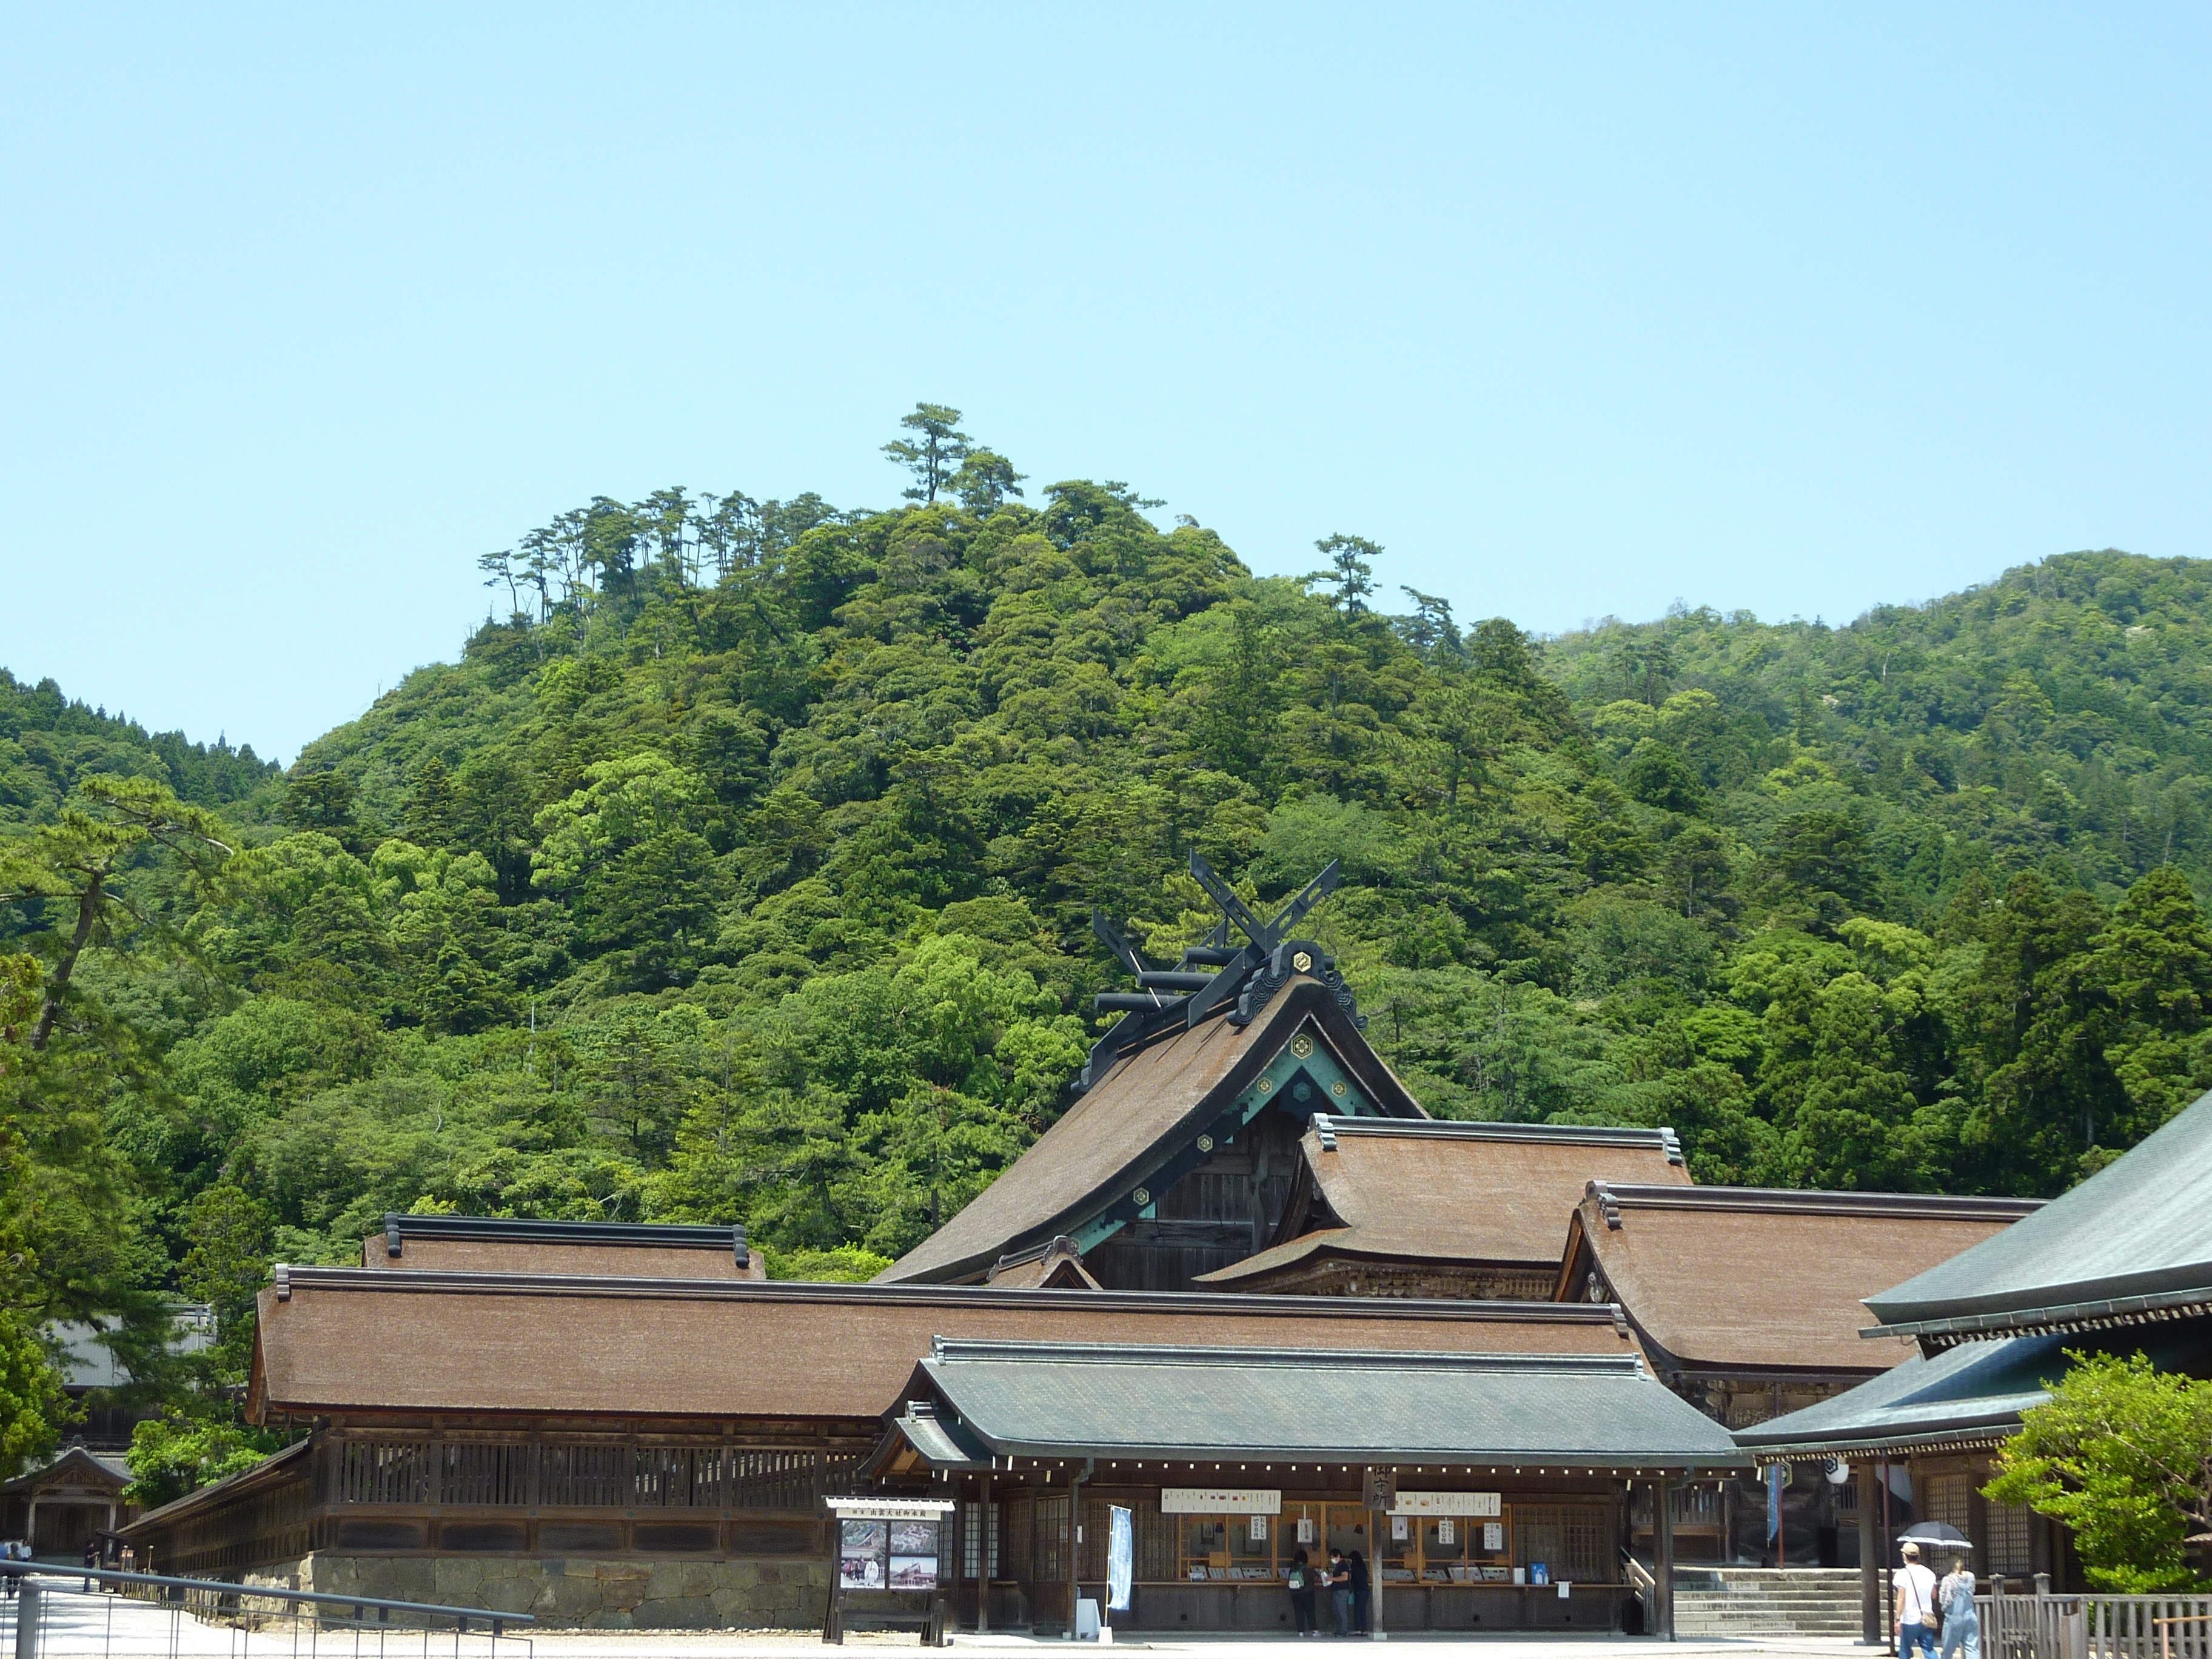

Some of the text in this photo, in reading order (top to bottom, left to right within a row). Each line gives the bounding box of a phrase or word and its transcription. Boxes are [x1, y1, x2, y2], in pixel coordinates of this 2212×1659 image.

[1371, 1466, 1391, 1507] 御守所
[870, 1509, 927, 1517] 出雲大社御本殿
